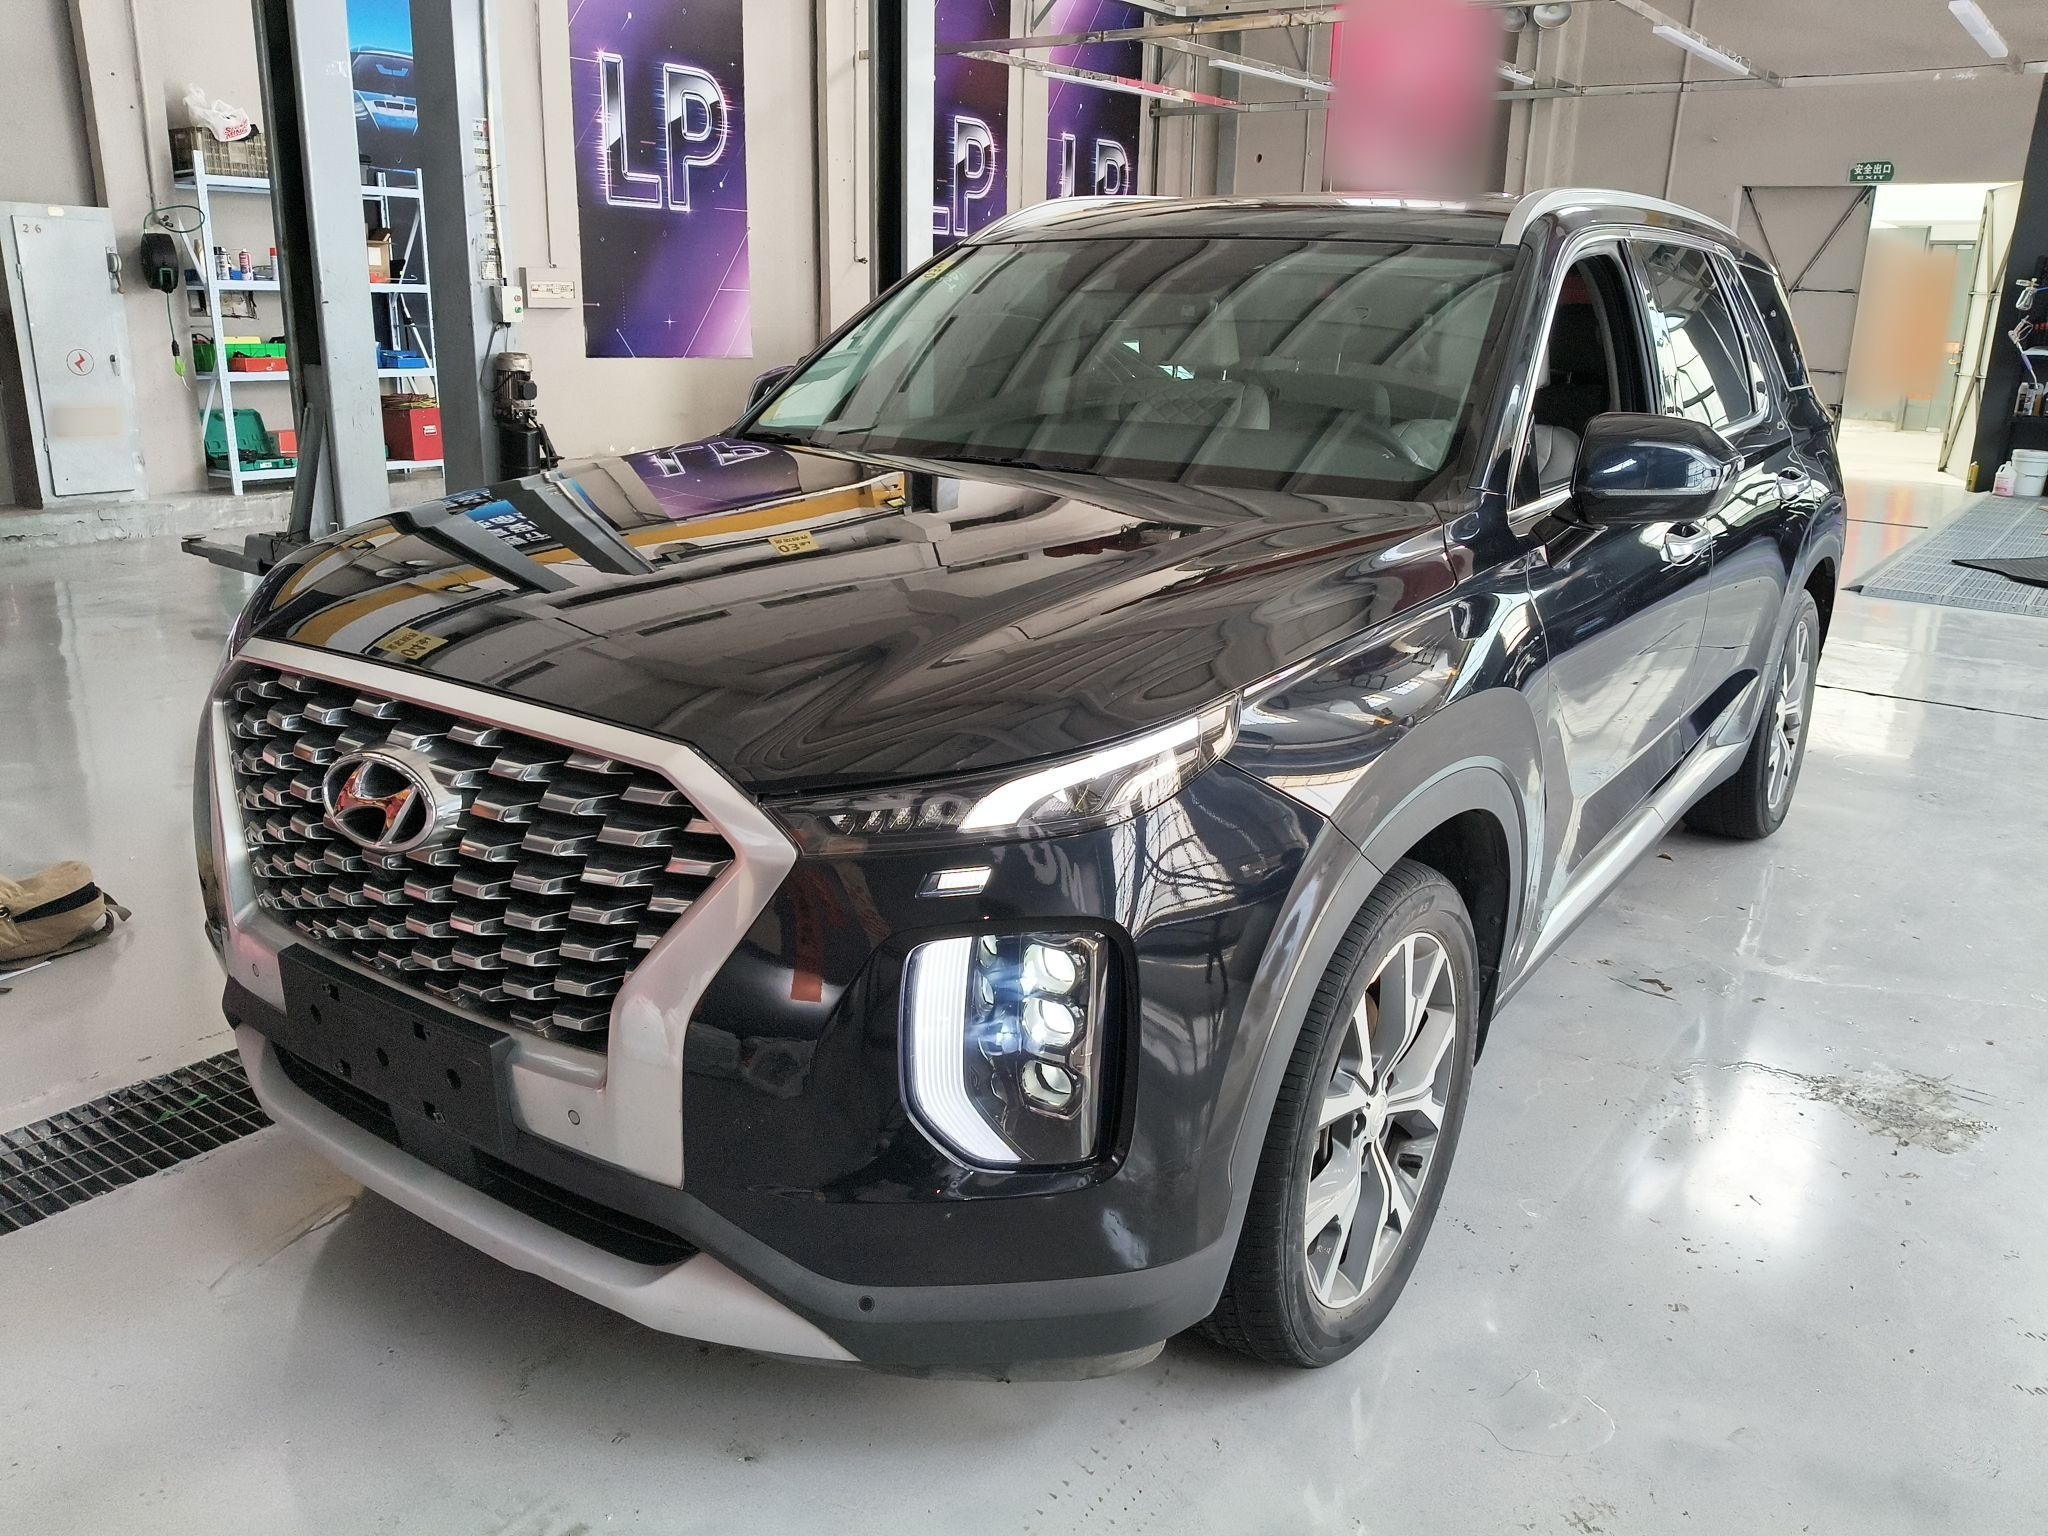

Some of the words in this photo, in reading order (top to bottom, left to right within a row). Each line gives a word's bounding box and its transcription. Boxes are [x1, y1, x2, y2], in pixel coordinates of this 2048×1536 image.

[600, 53, 727, 211] LP
[1854, 163, 1891, 175] 安全出口
